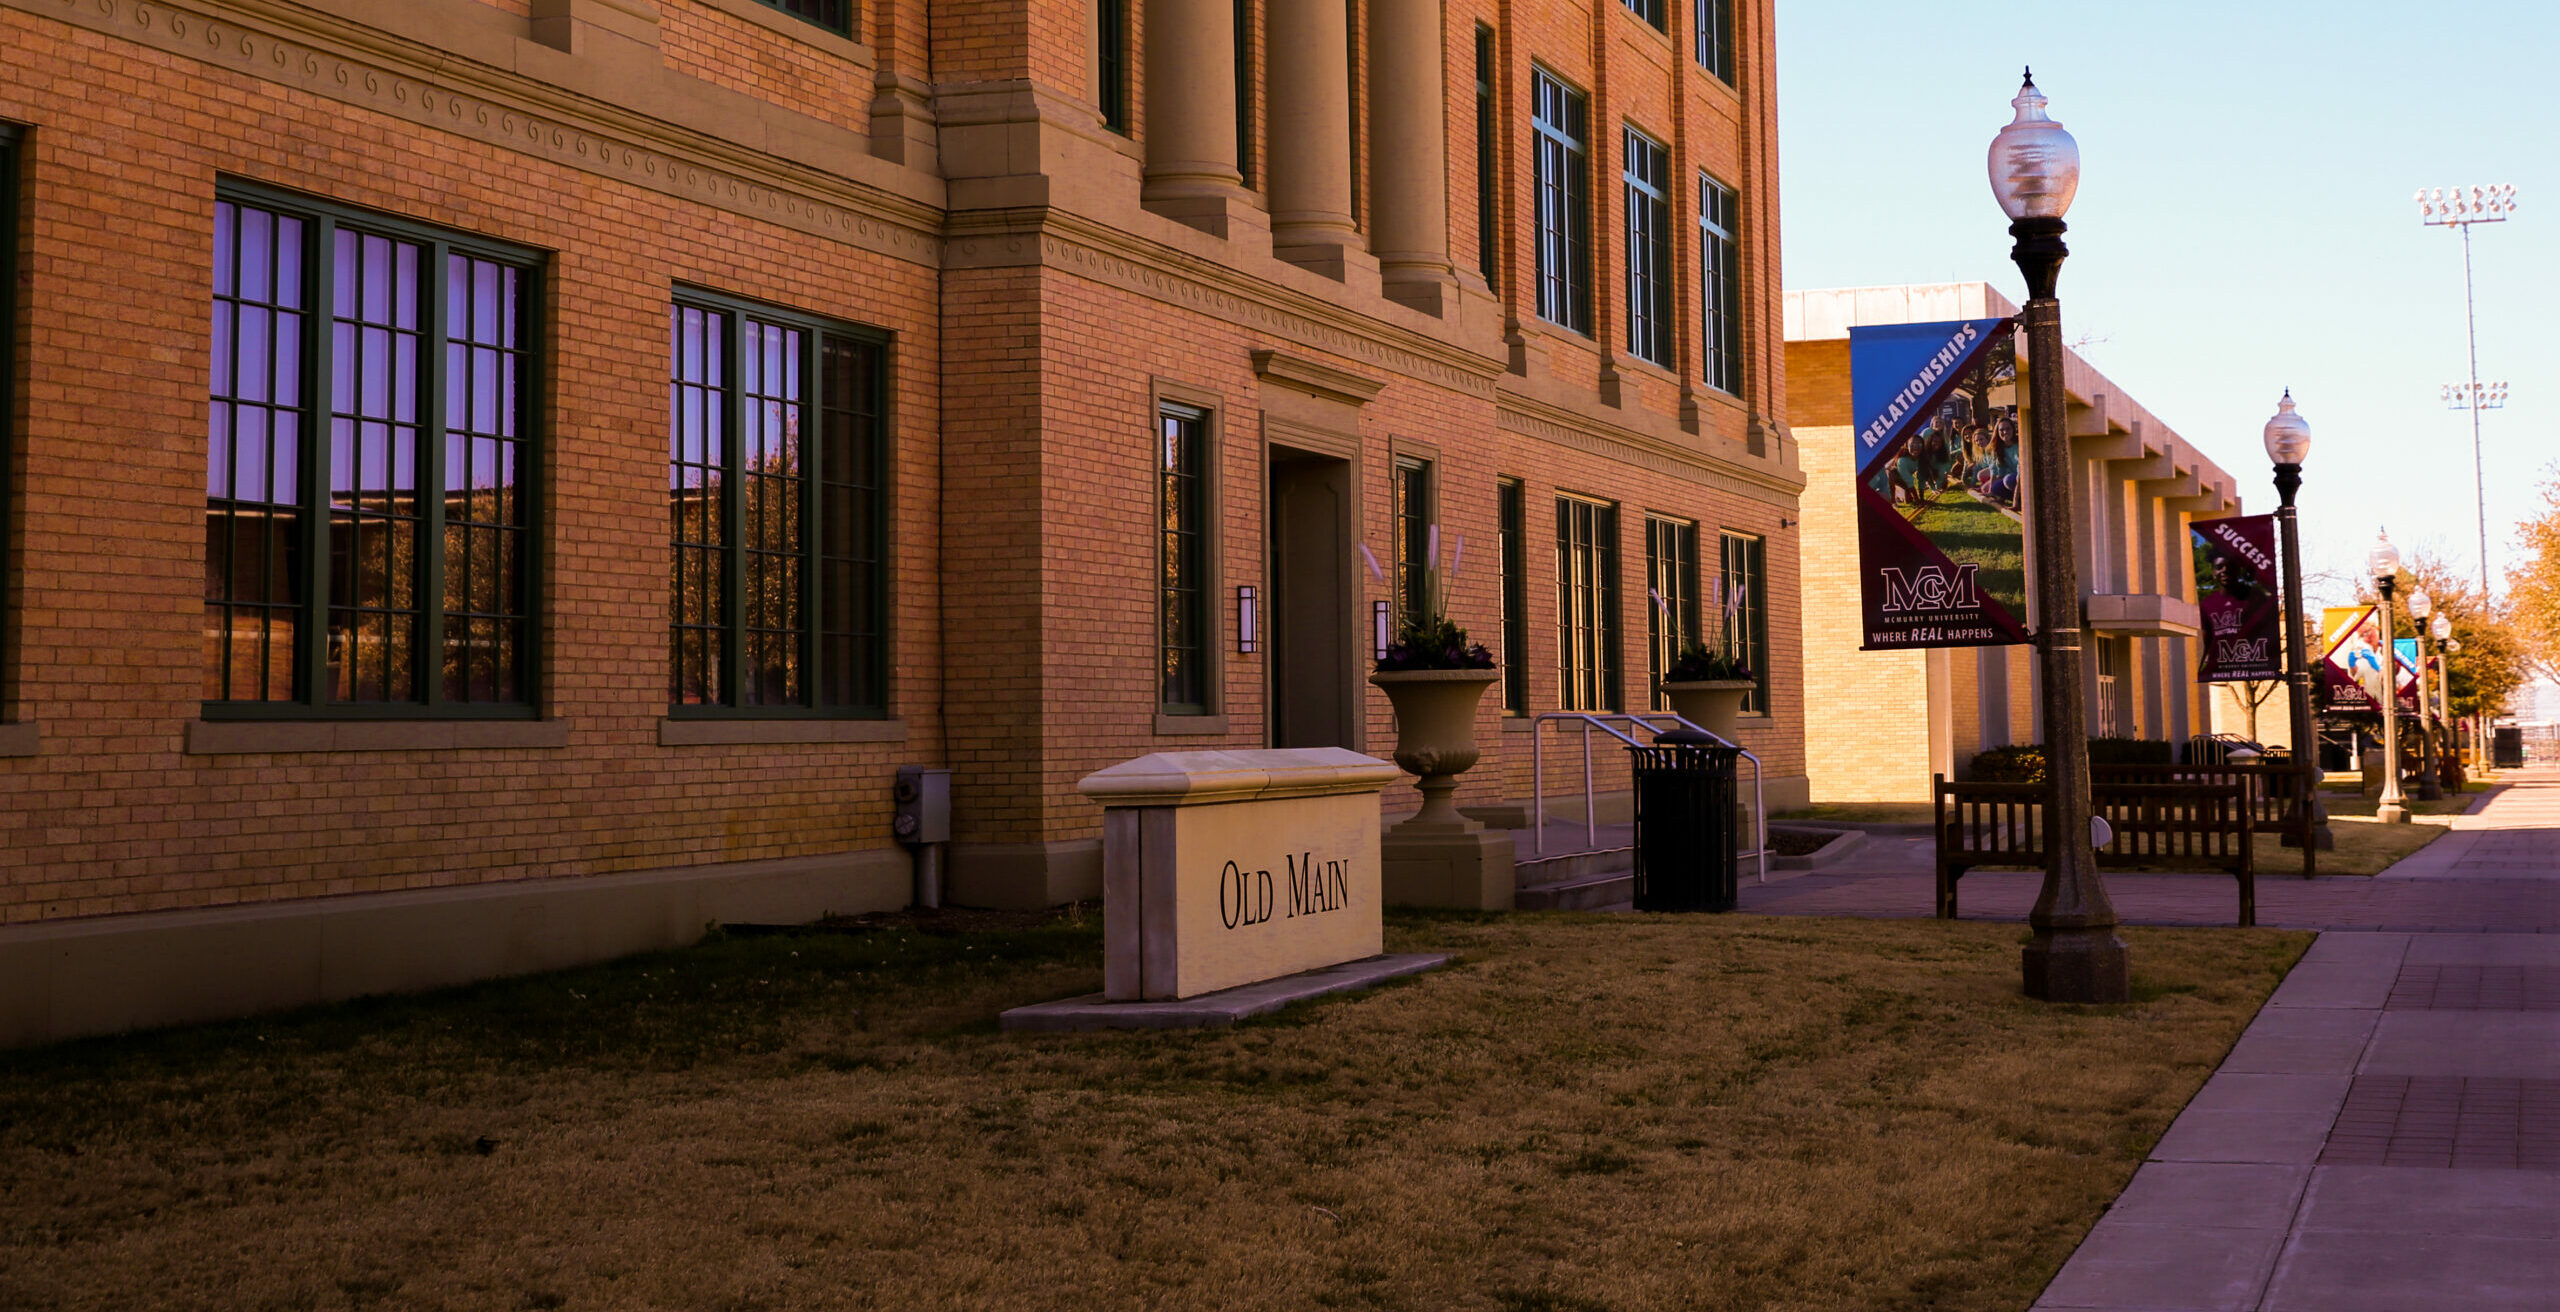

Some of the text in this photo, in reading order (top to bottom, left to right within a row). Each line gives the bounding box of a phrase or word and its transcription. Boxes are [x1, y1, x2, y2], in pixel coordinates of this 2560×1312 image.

[1861, 322, 1977, 448] RELATIONSHIPS
[2214, 523, 2272, 571] SUCCESS
[1884, 613, 1979, 624] MCMURRY UNIVERSITY
[1872, 627, 1993, 643] WHERE REAL HAPPENS
